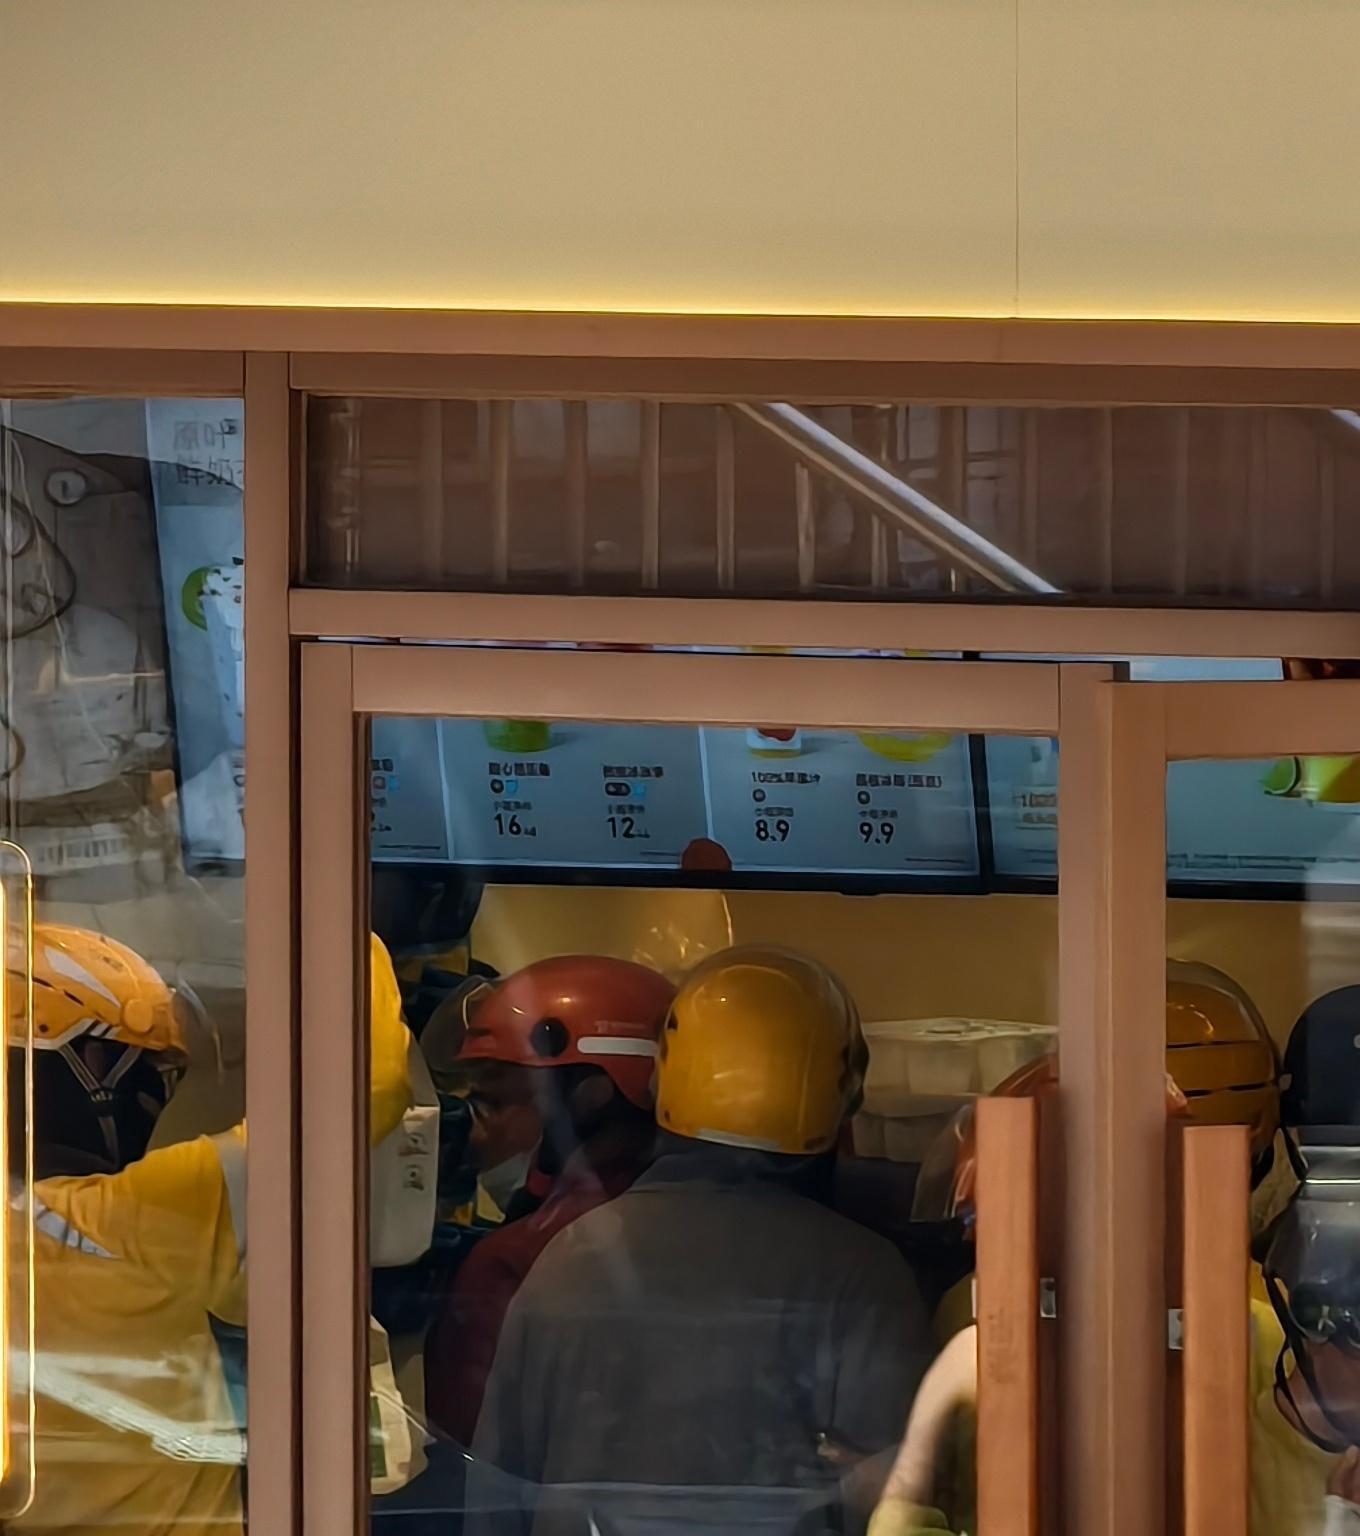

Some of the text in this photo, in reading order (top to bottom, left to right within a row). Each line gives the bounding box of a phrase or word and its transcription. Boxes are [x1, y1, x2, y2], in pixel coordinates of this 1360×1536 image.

[493, 813, 523, 836] 16
[606, 816, 636, 839] 12
[754, 819, 790, 842] 8.9
[859, 821, 894, 844] 9.9
